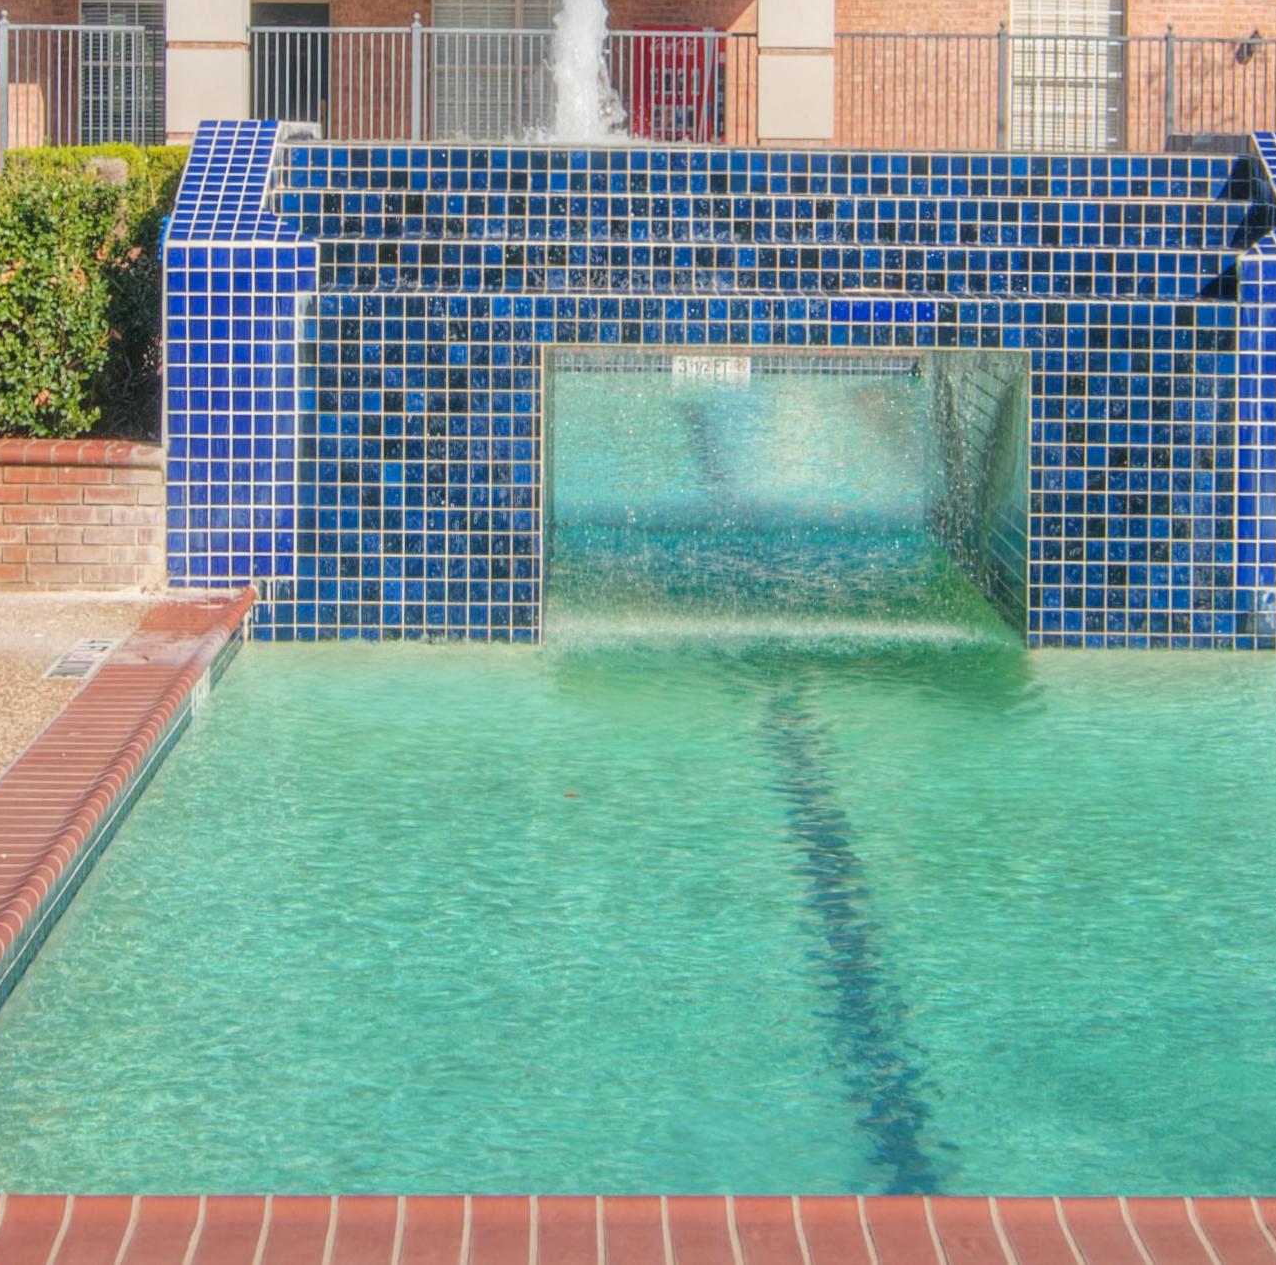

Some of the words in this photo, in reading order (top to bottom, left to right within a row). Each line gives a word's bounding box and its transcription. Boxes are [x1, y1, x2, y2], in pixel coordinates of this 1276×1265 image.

[678, 358, 687, 373] 3
[695, 360, 710, 372] 1/2
[714, 358, 729, 375] FT
